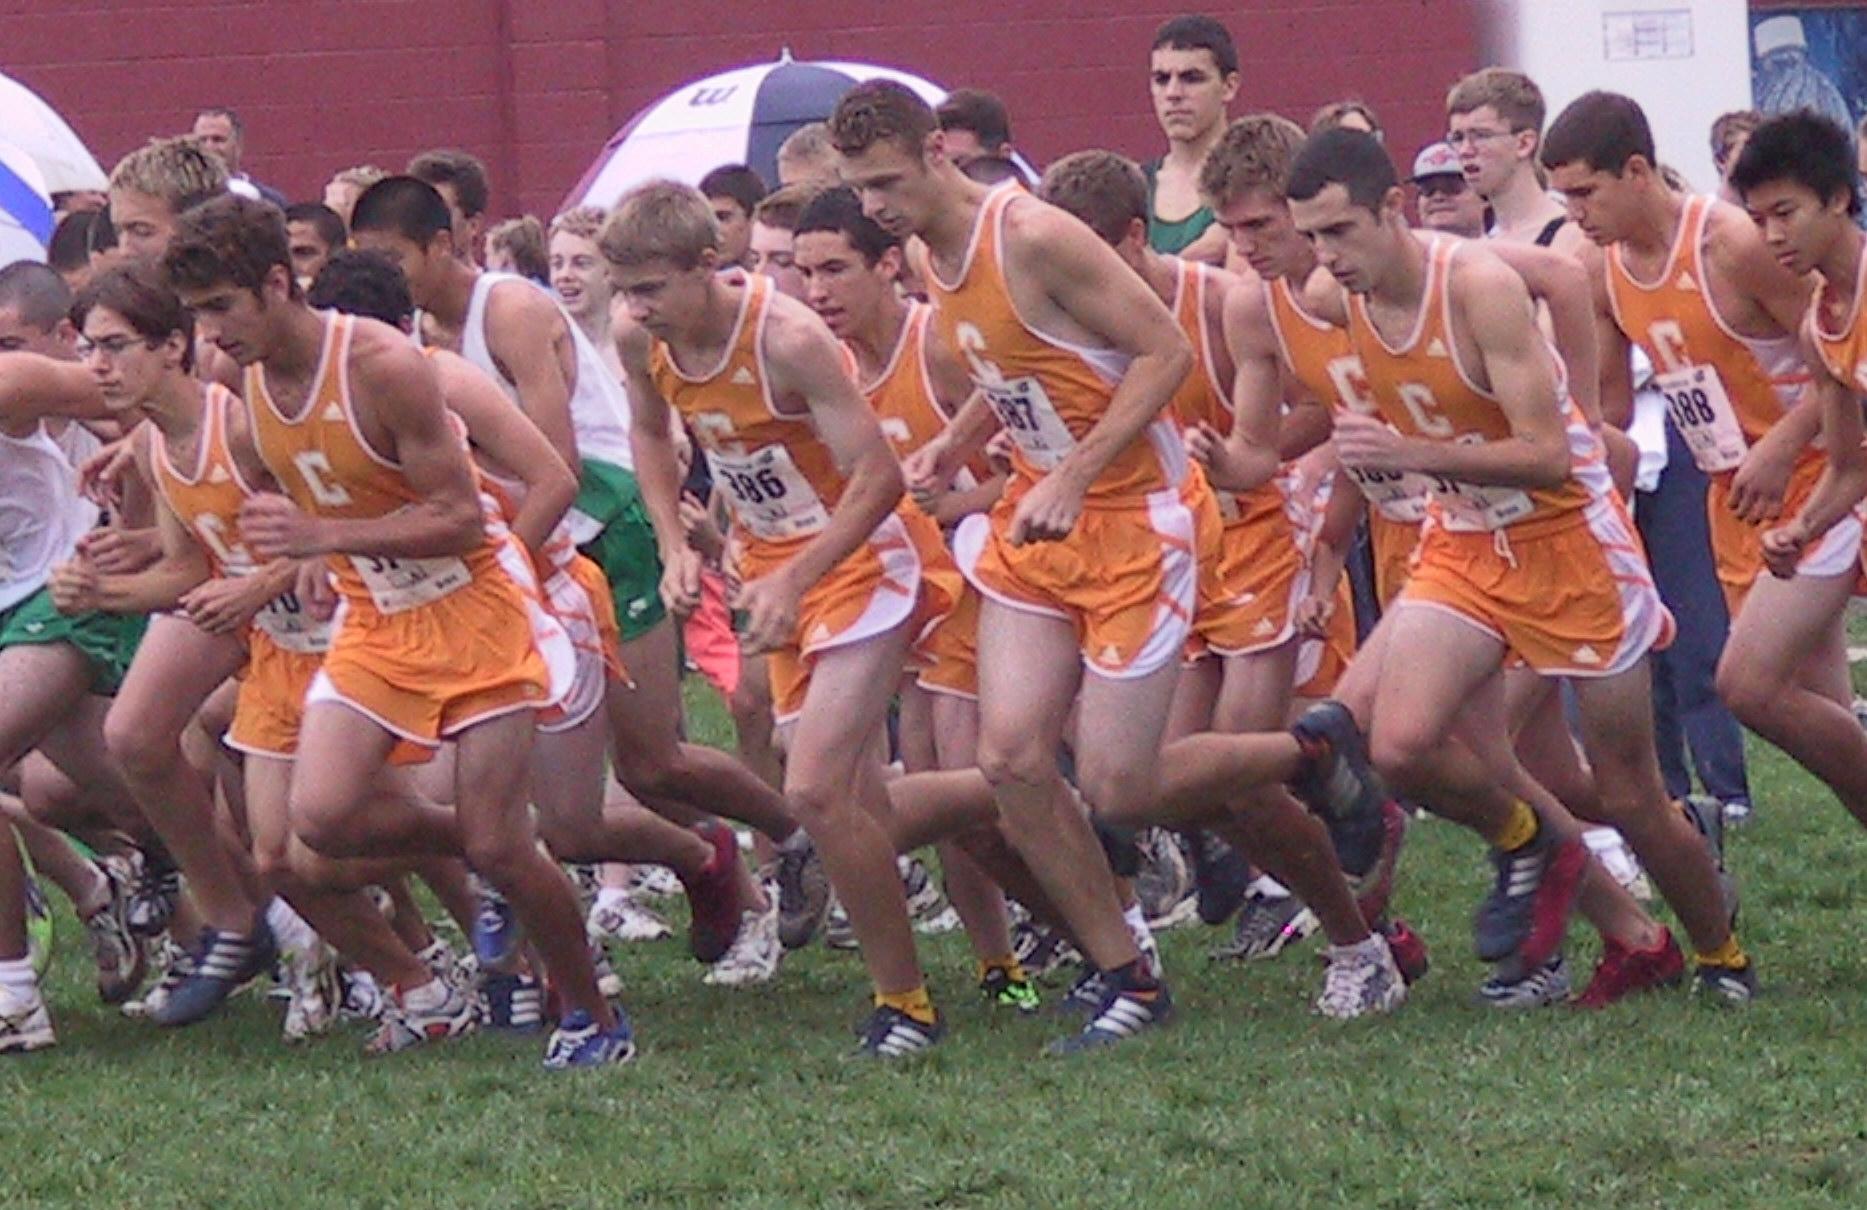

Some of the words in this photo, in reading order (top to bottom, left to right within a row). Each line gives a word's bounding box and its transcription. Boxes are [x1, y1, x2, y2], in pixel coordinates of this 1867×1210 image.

[1327, 355, 1380, 413] C
[1399, 382, 1455, 437] C
[294, 451, 352, 506] C
